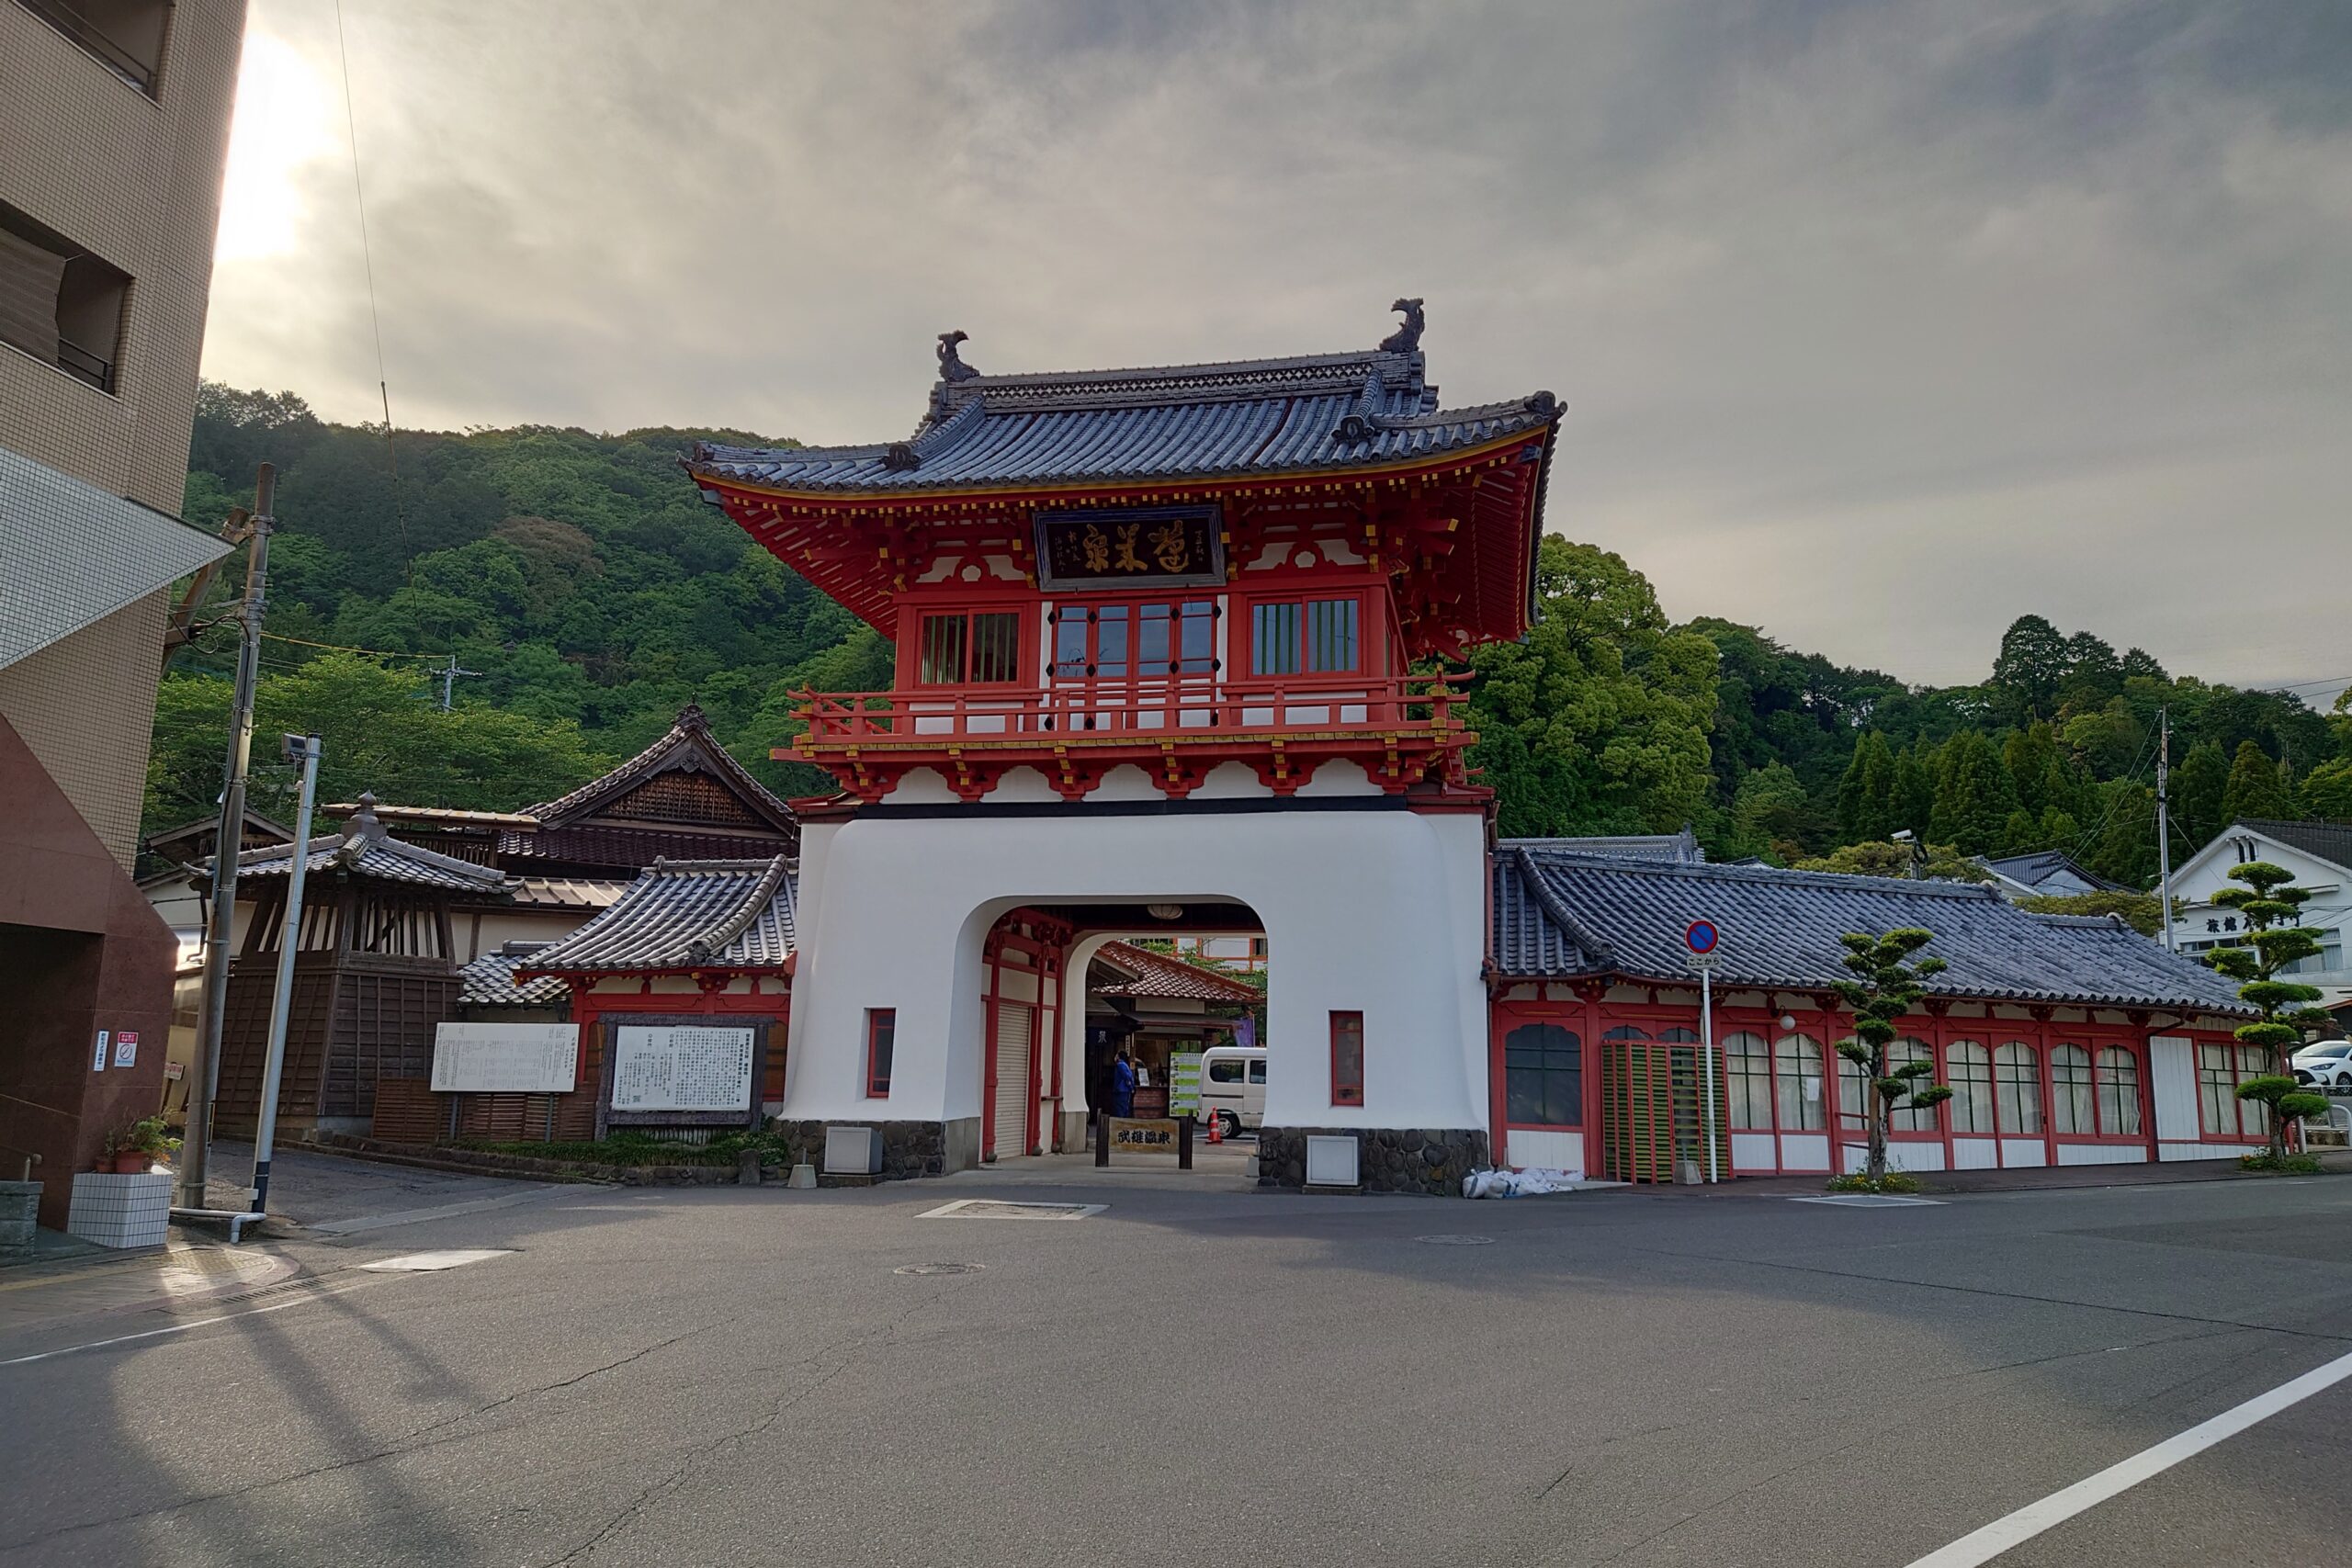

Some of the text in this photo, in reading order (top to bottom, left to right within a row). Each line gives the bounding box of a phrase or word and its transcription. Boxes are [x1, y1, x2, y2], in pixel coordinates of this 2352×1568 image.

[1689, 957, 1720, 965] ここから
[1118, 1129, 1170, 1145] 武雄温泉
